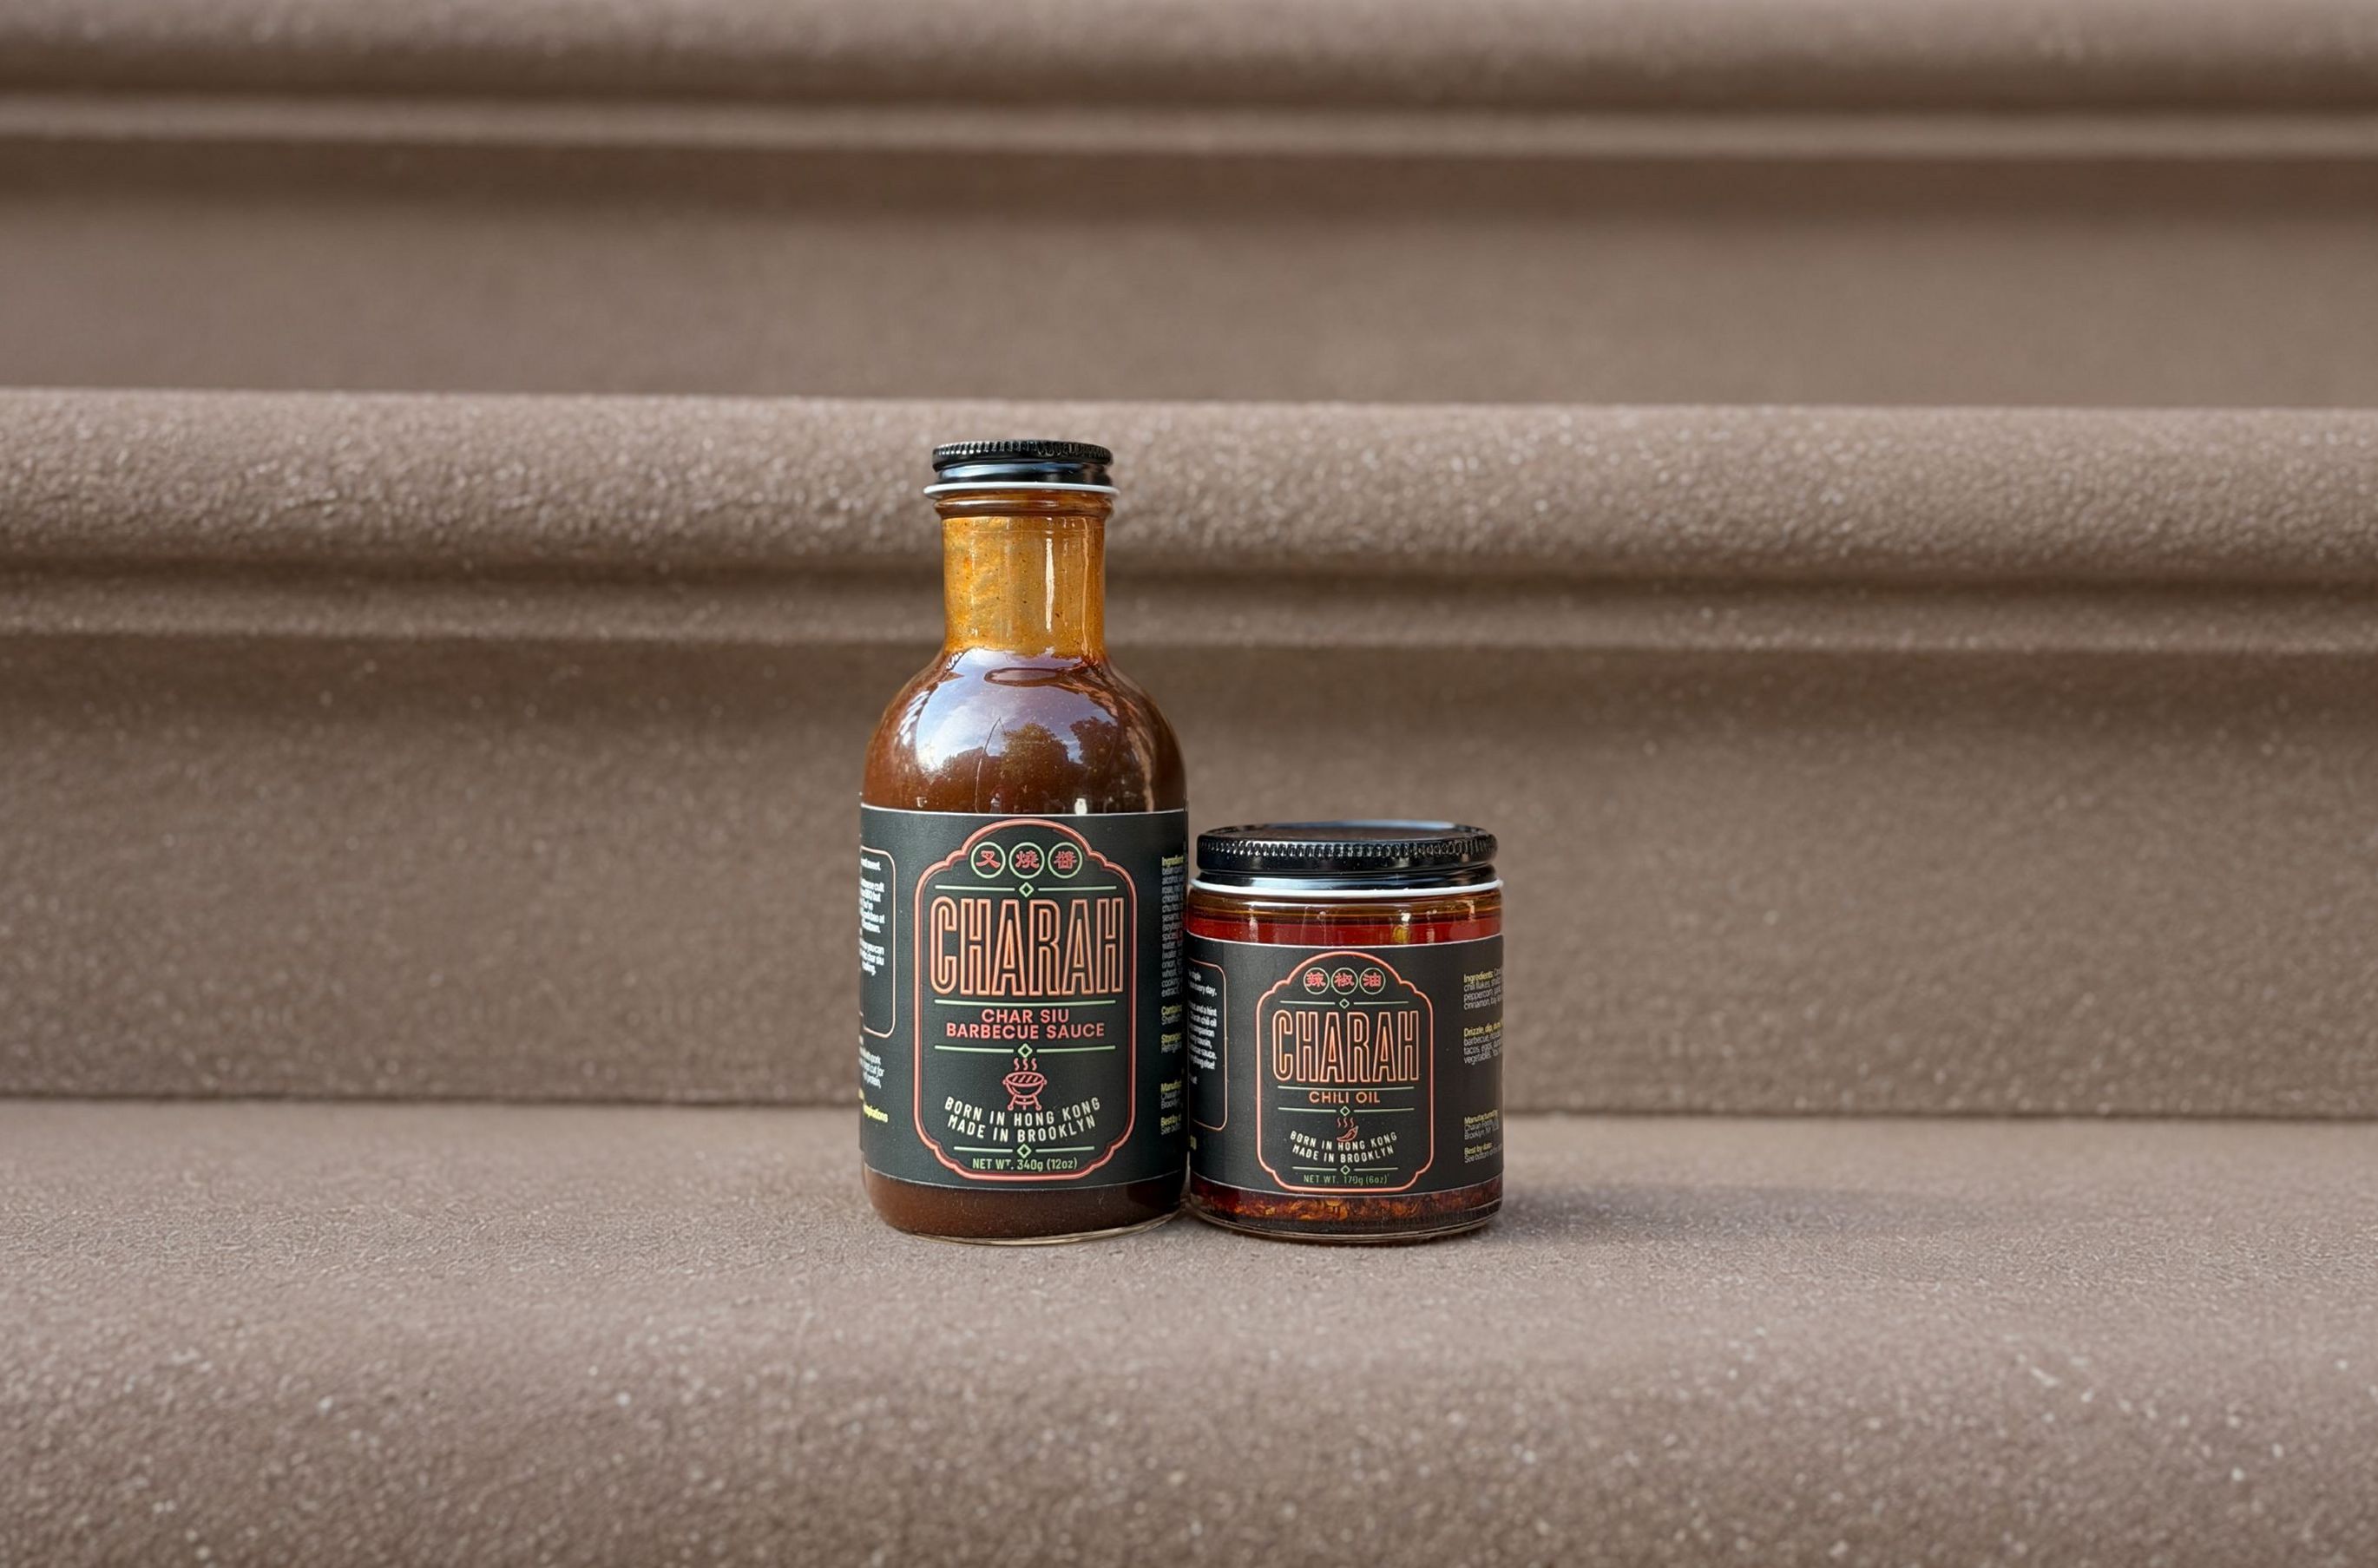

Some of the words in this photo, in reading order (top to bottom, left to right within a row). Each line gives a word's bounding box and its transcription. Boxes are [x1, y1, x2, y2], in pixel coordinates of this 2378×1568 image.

[930, 896, 1125, 996] CHARAH
[1304, 970, 1383, 989] 辣椒油
[981, 1008, 1033, 1024] CHAR
[1040, 1008, 1069, 1023] SIU
[946, 1023, 1039, 1040] BARBECUE
[1046, 1022, 1105, 1040] SAUCE
[1272, 1009, 1419, 1083] CHARAH
[1309, 1091, 1350, 1104] CHILI
[1356, 1091, 1381, 1104] OIL
[944, 1096, 982, 1121] BORN
[989, 1111, 1005, 1126] IN
[1014, 1111, 1054, 1127] HONG
[1061, 1097, 1100, 1122] KONG
[948, 1114, 986, 1139] MADE
[993, 1126, 1008, 1143] IN
[1017, 1115, 1096, 1143] BROOKLYN
[1290, 1130, 1317, 1148] BORN
[1321, 1139, 1333, 1151] IN
[1337, 1140, 1366, 1151] HONG
[1370, 1132, 1397, 1148] KONG
[1291, 1144, 1319, 1161] MADE
[1324, 1153, 1335, 1163] IN
[1340, 1145, 1395, 1164] BROOKLYN
[972, 1158, 993, 1170] NET
[995, 1158, 1014, 1170] WT.
[1016, 1158, 1043, 1171] 340g
[1046, 1157, 1078, 1171] (12oz)
[1304, 1174, 1320, 1184] NET
